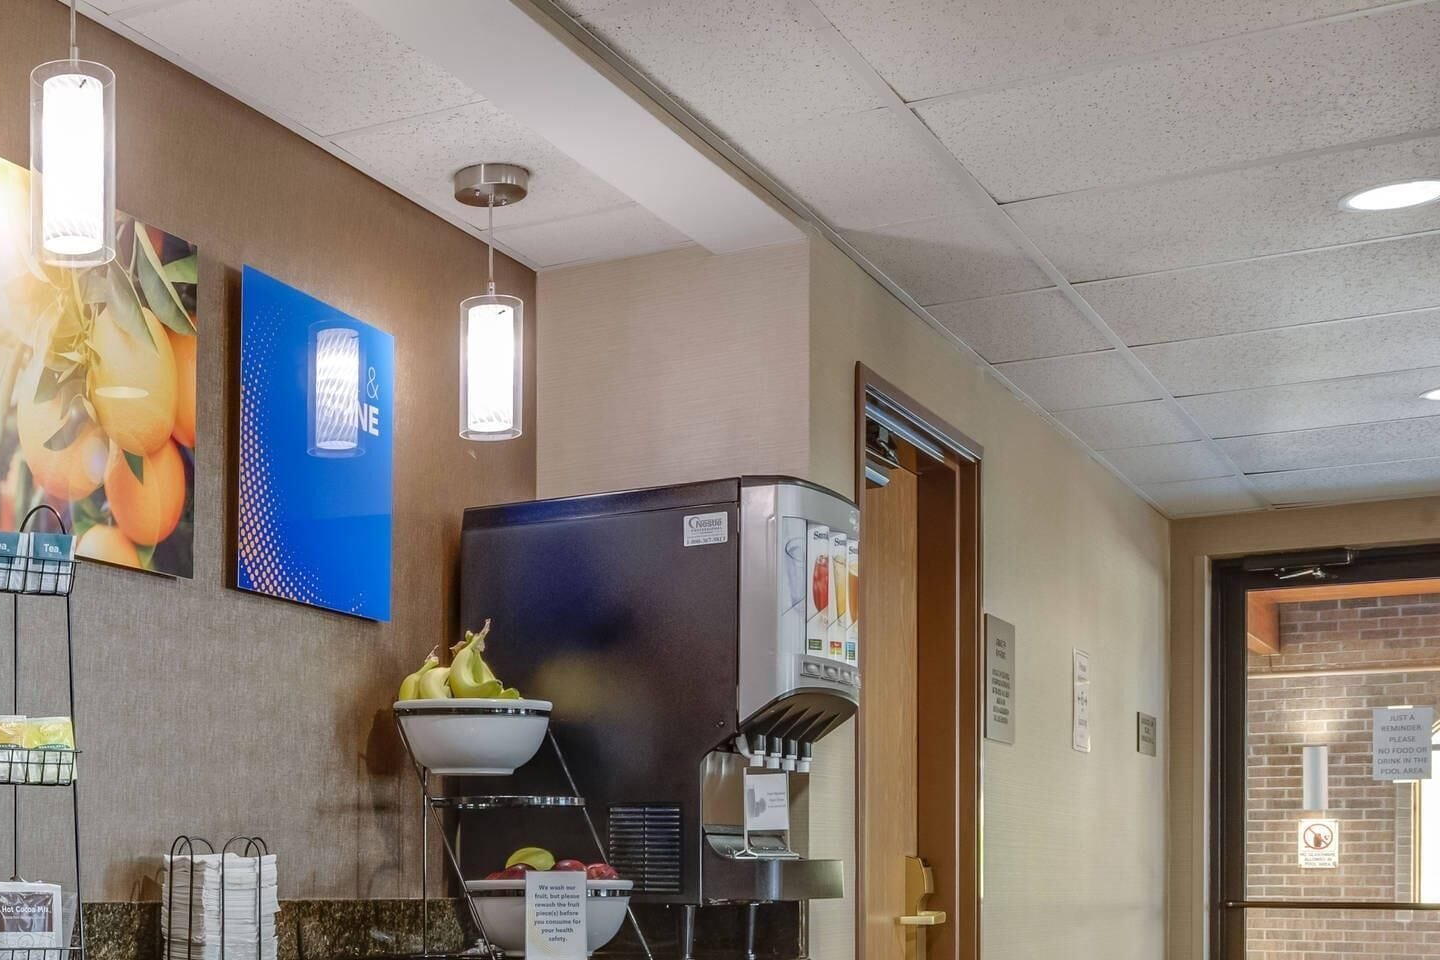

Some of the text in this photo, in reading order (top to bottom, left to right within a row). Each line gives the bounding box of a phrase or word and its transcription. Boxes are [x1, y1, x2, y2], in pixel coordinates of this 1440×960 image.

[1388, 735, 1416, 743] PLEASE
[1378, 747, 1390, 755] NO
[1392, 746, 1415, 754] FOOD
[1, 904, 14, 913] Hot
[15, 905, 36, 913] Cocoa
